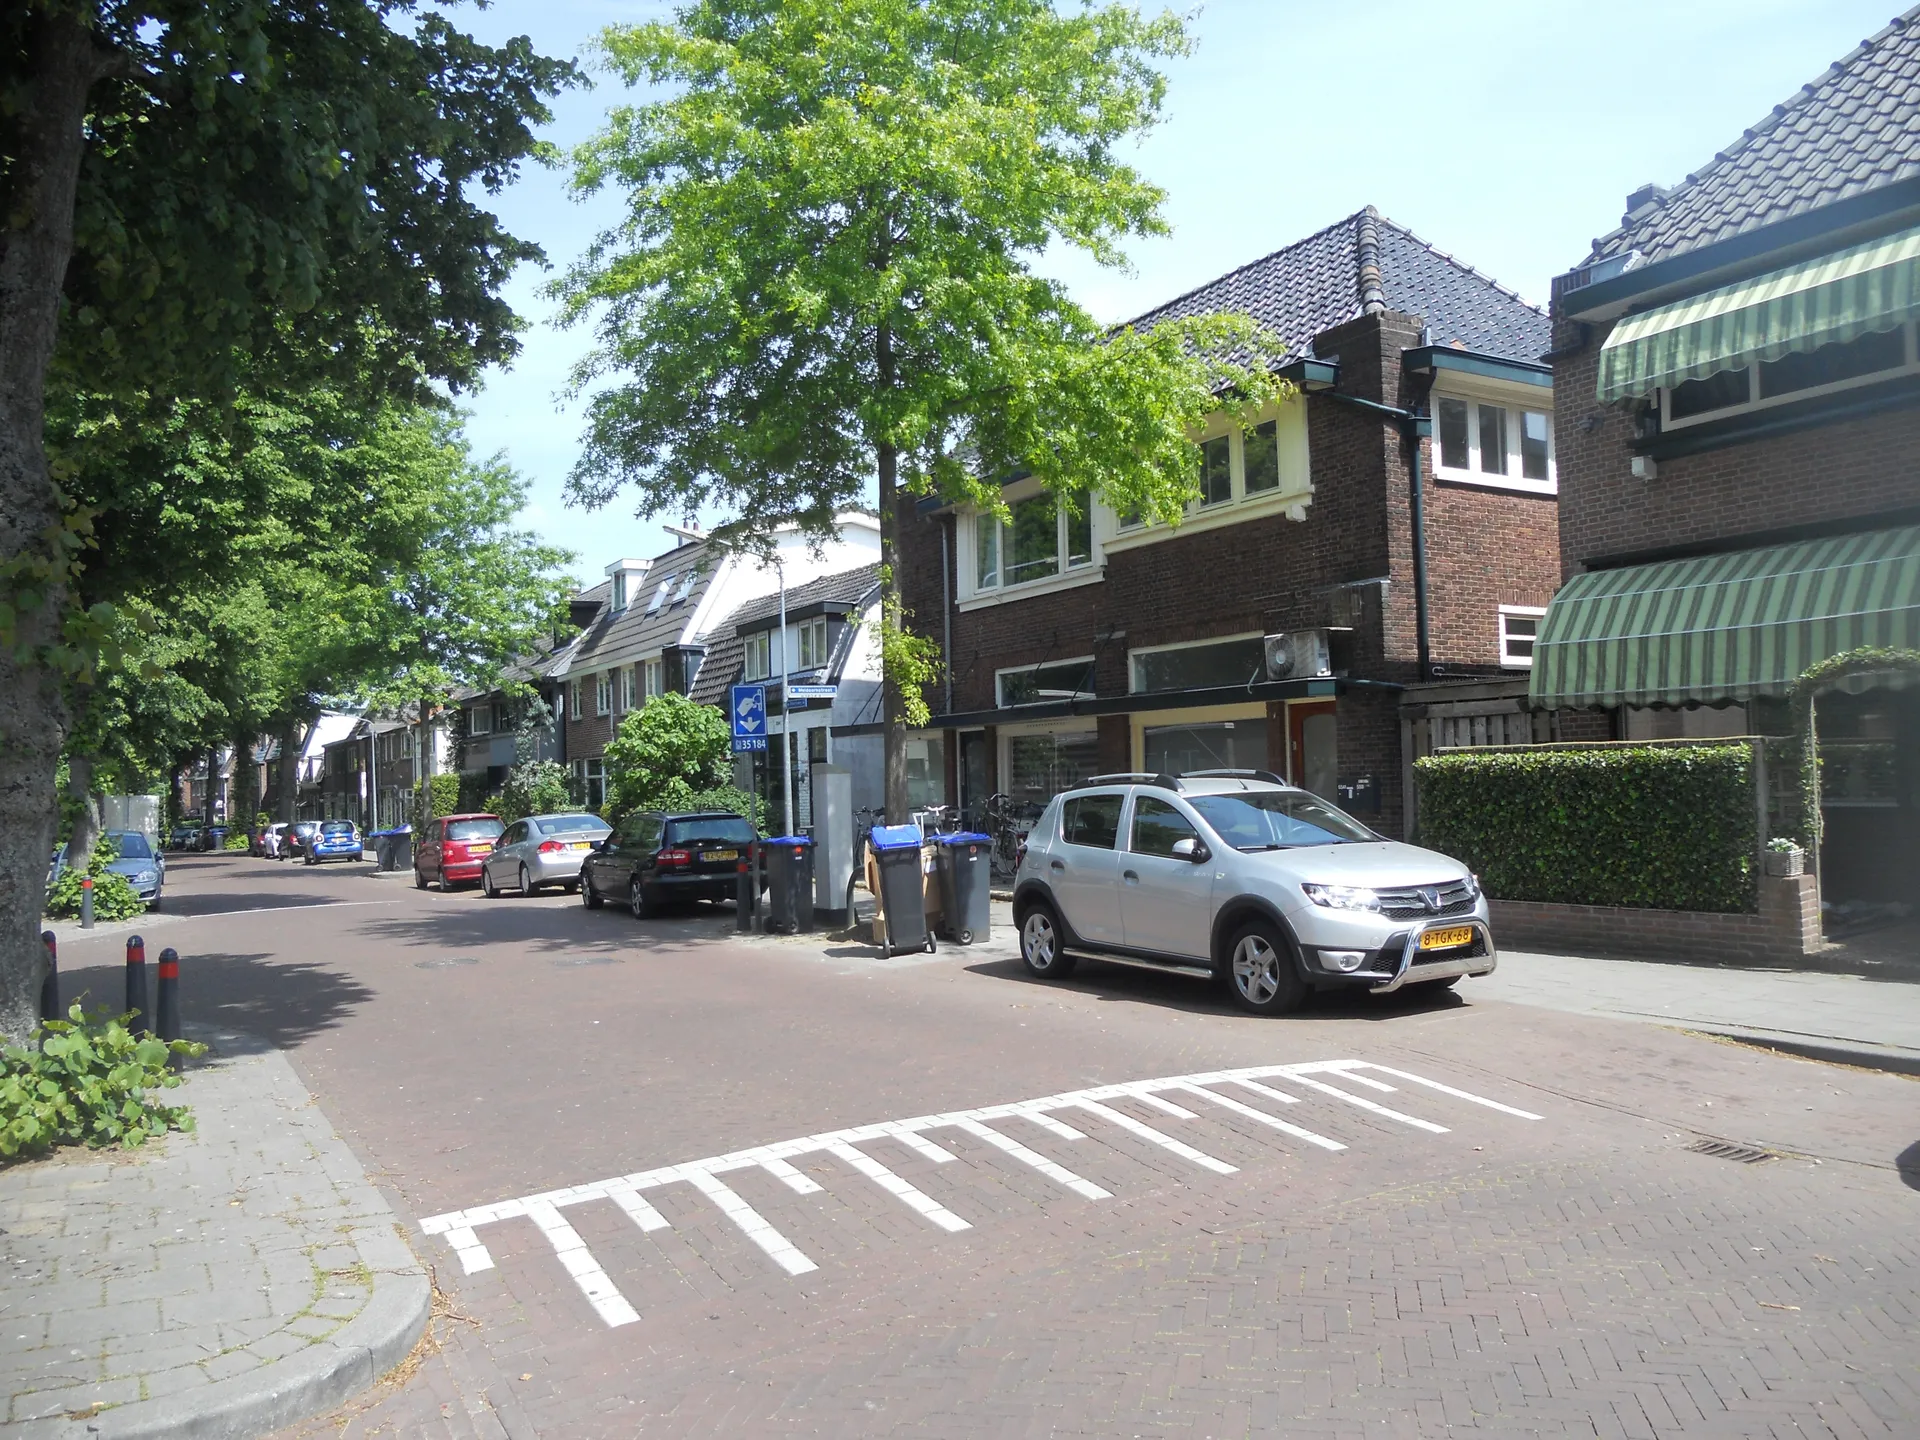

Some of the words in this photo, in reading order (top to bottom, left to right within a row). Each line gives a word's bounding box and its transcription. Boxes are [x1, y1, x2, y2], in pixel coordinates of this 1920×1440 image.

[742, 739, 751, 750] 35
[752, 739, 766, 749] 184
[1423, 928, 1469, 946] 8-TGK-68
